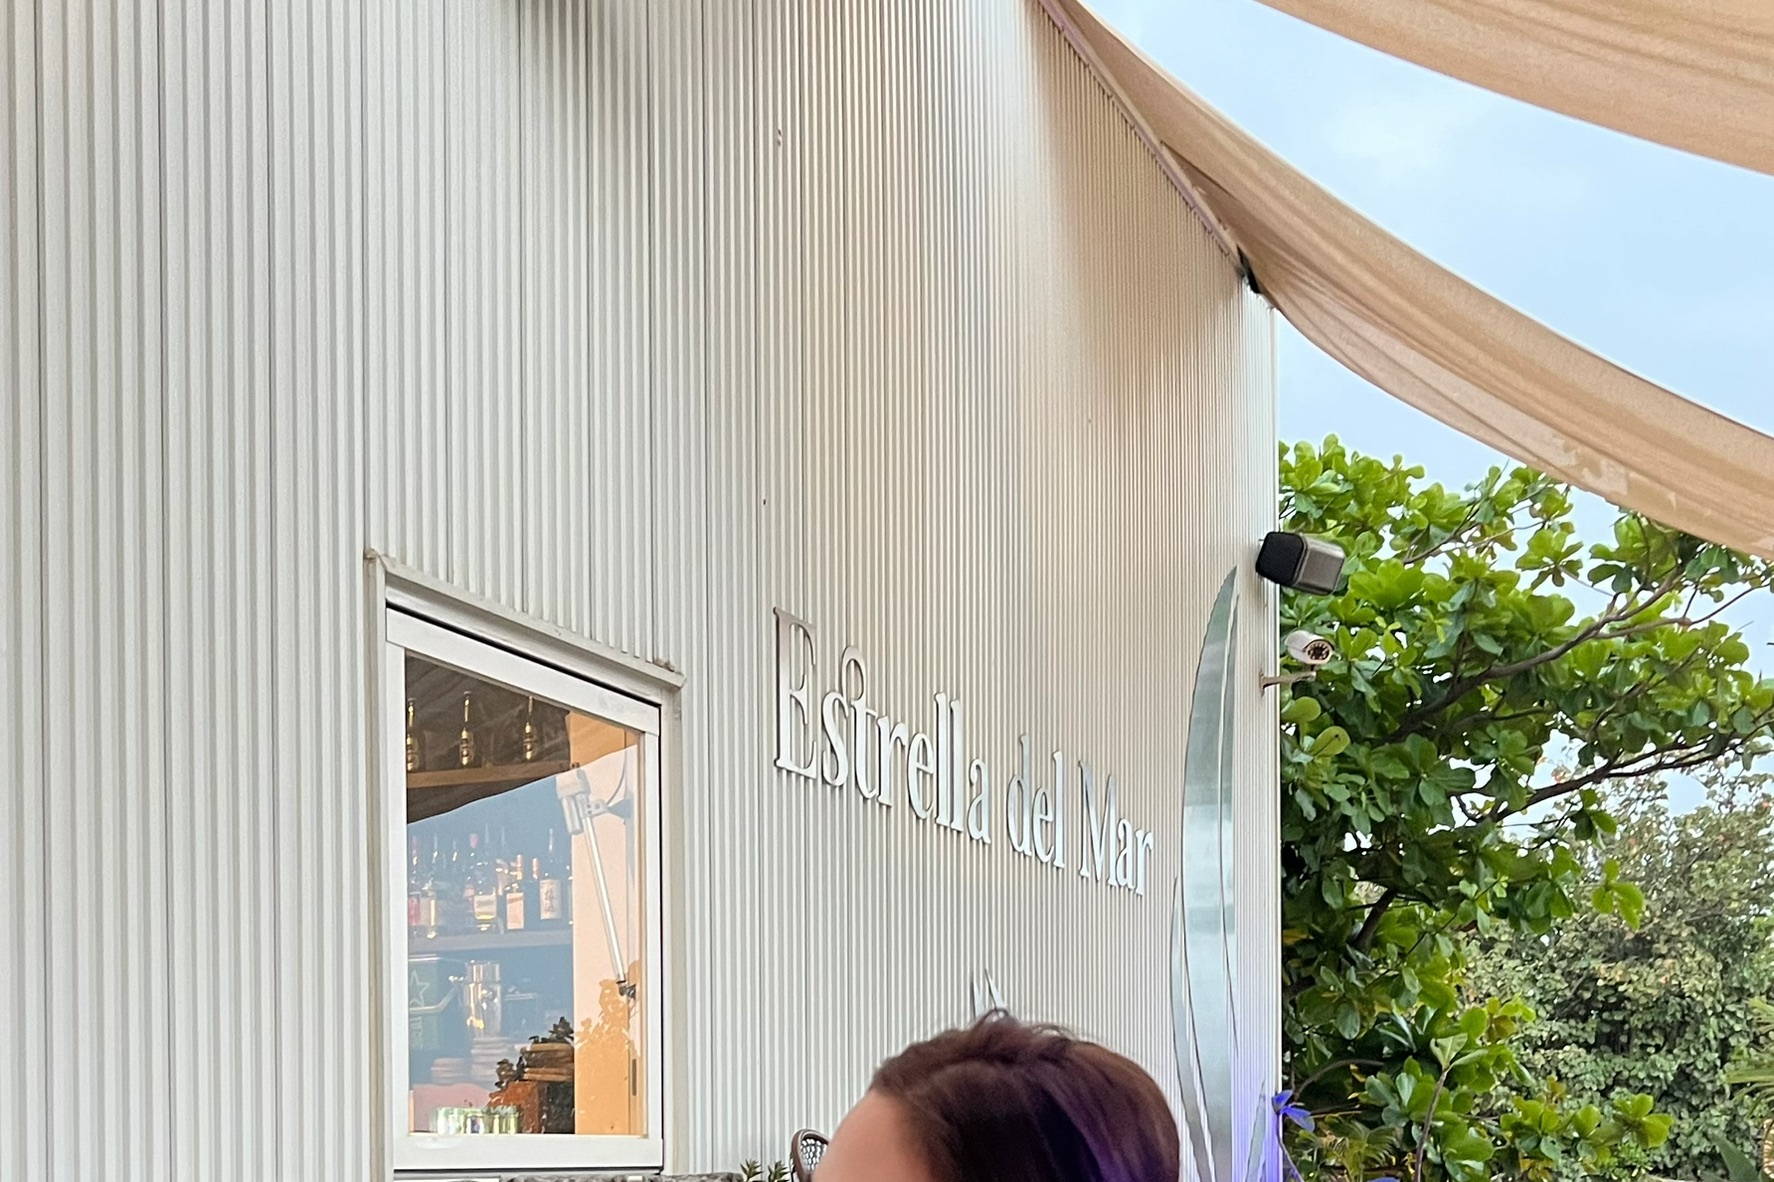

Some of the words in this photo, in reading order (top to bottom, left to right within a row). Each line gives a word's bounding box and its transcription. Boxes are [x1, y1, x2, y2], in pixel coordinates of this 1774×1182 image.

[773, 606, 992, 845] Estrella
[1005, 733, 1065, 869] del
[1077, 760, 1154, 896] Mar
